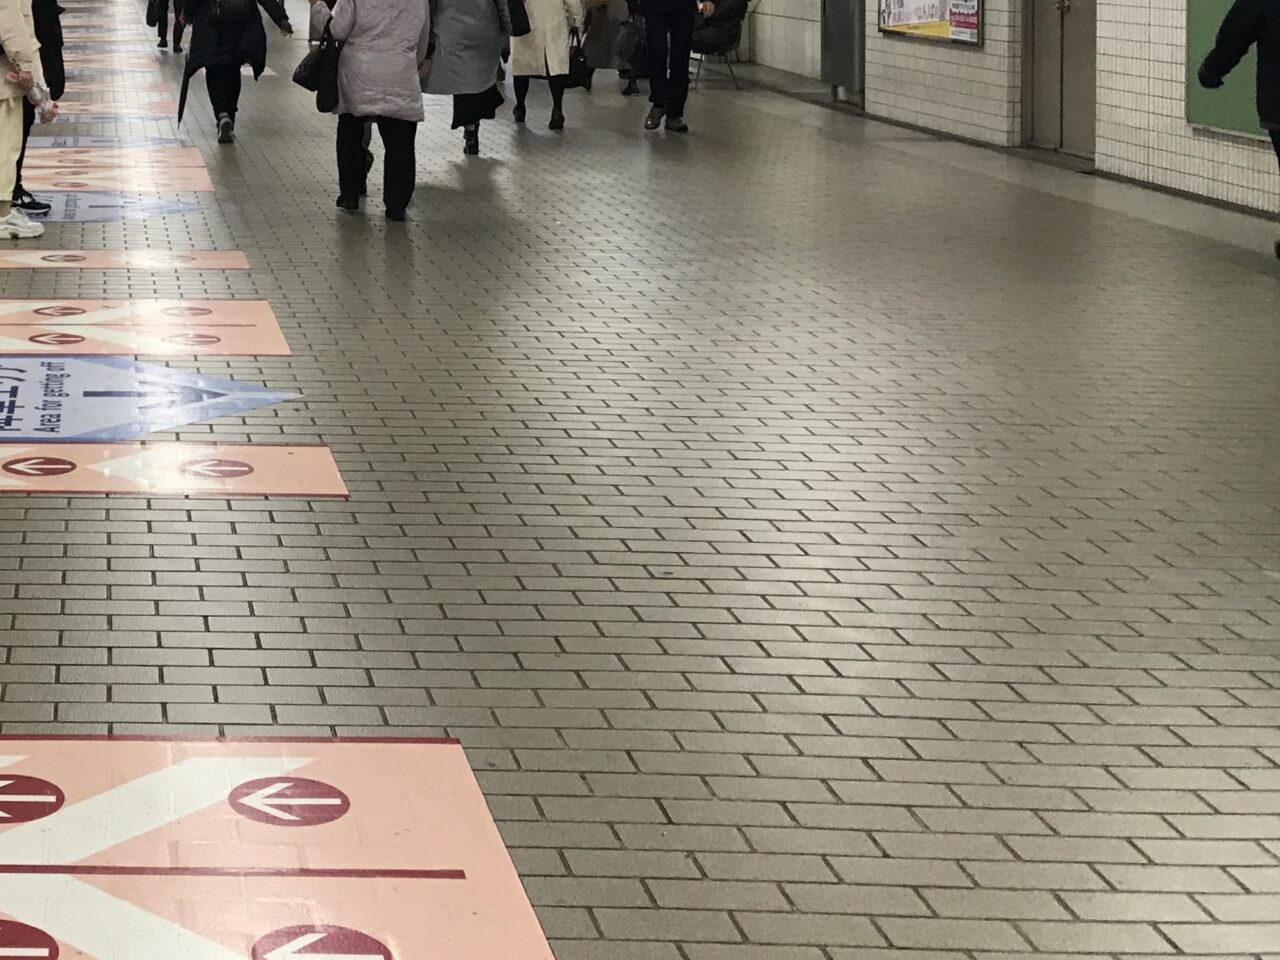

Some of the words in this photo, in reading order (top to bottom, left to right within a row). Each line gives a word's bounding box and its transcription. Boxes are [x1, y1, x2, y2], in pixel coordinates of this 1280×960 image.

[40, 361, 65, 372] off
[38, 373, 71, 398] getting
[34, 399, 62, 411] for
[33, 413, 61, 433] Area
